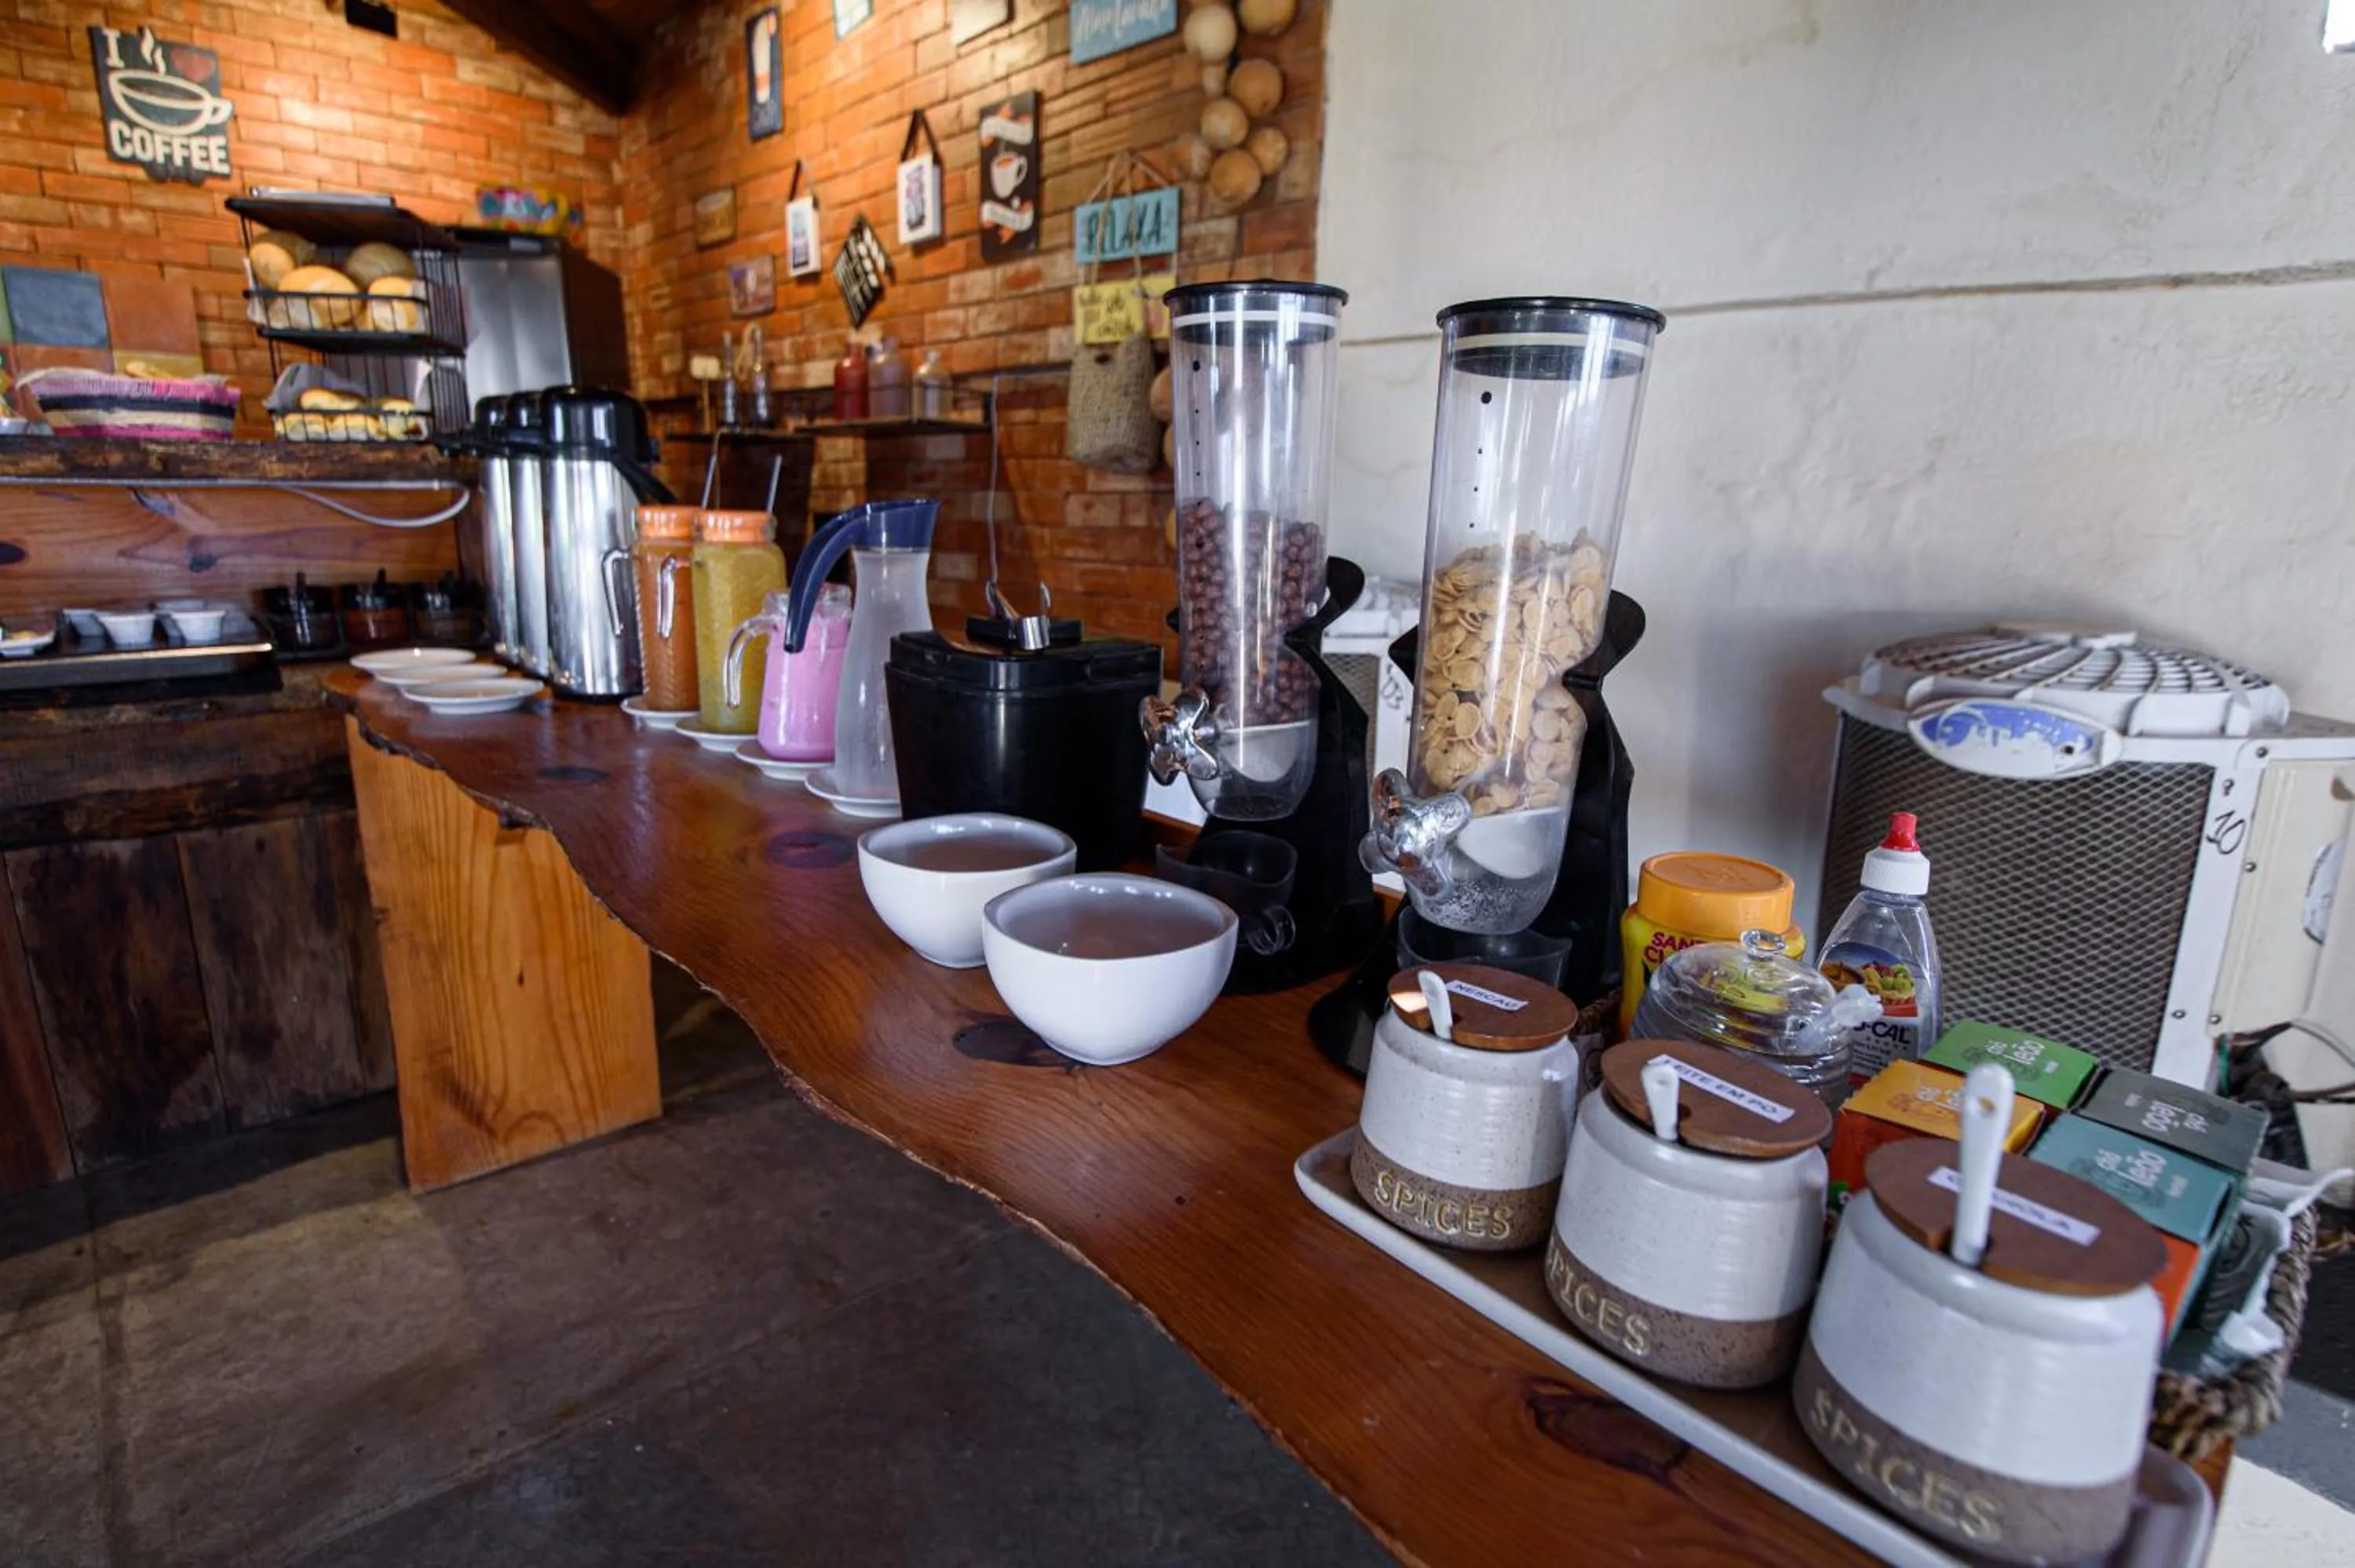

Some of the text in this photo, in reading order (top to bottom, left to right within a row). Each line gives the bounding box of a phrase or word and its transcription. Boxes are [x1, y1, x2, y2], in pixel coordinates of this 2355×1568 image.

[103, 28, 123, 68] I
[109, 120, 230, 174] COFFEE
[1455, 983, 1519, 1008] NESCAU
[1374, 1171, 1513, 1240] SPICES
[1810, 1387, 2003, 1543] SPICES
